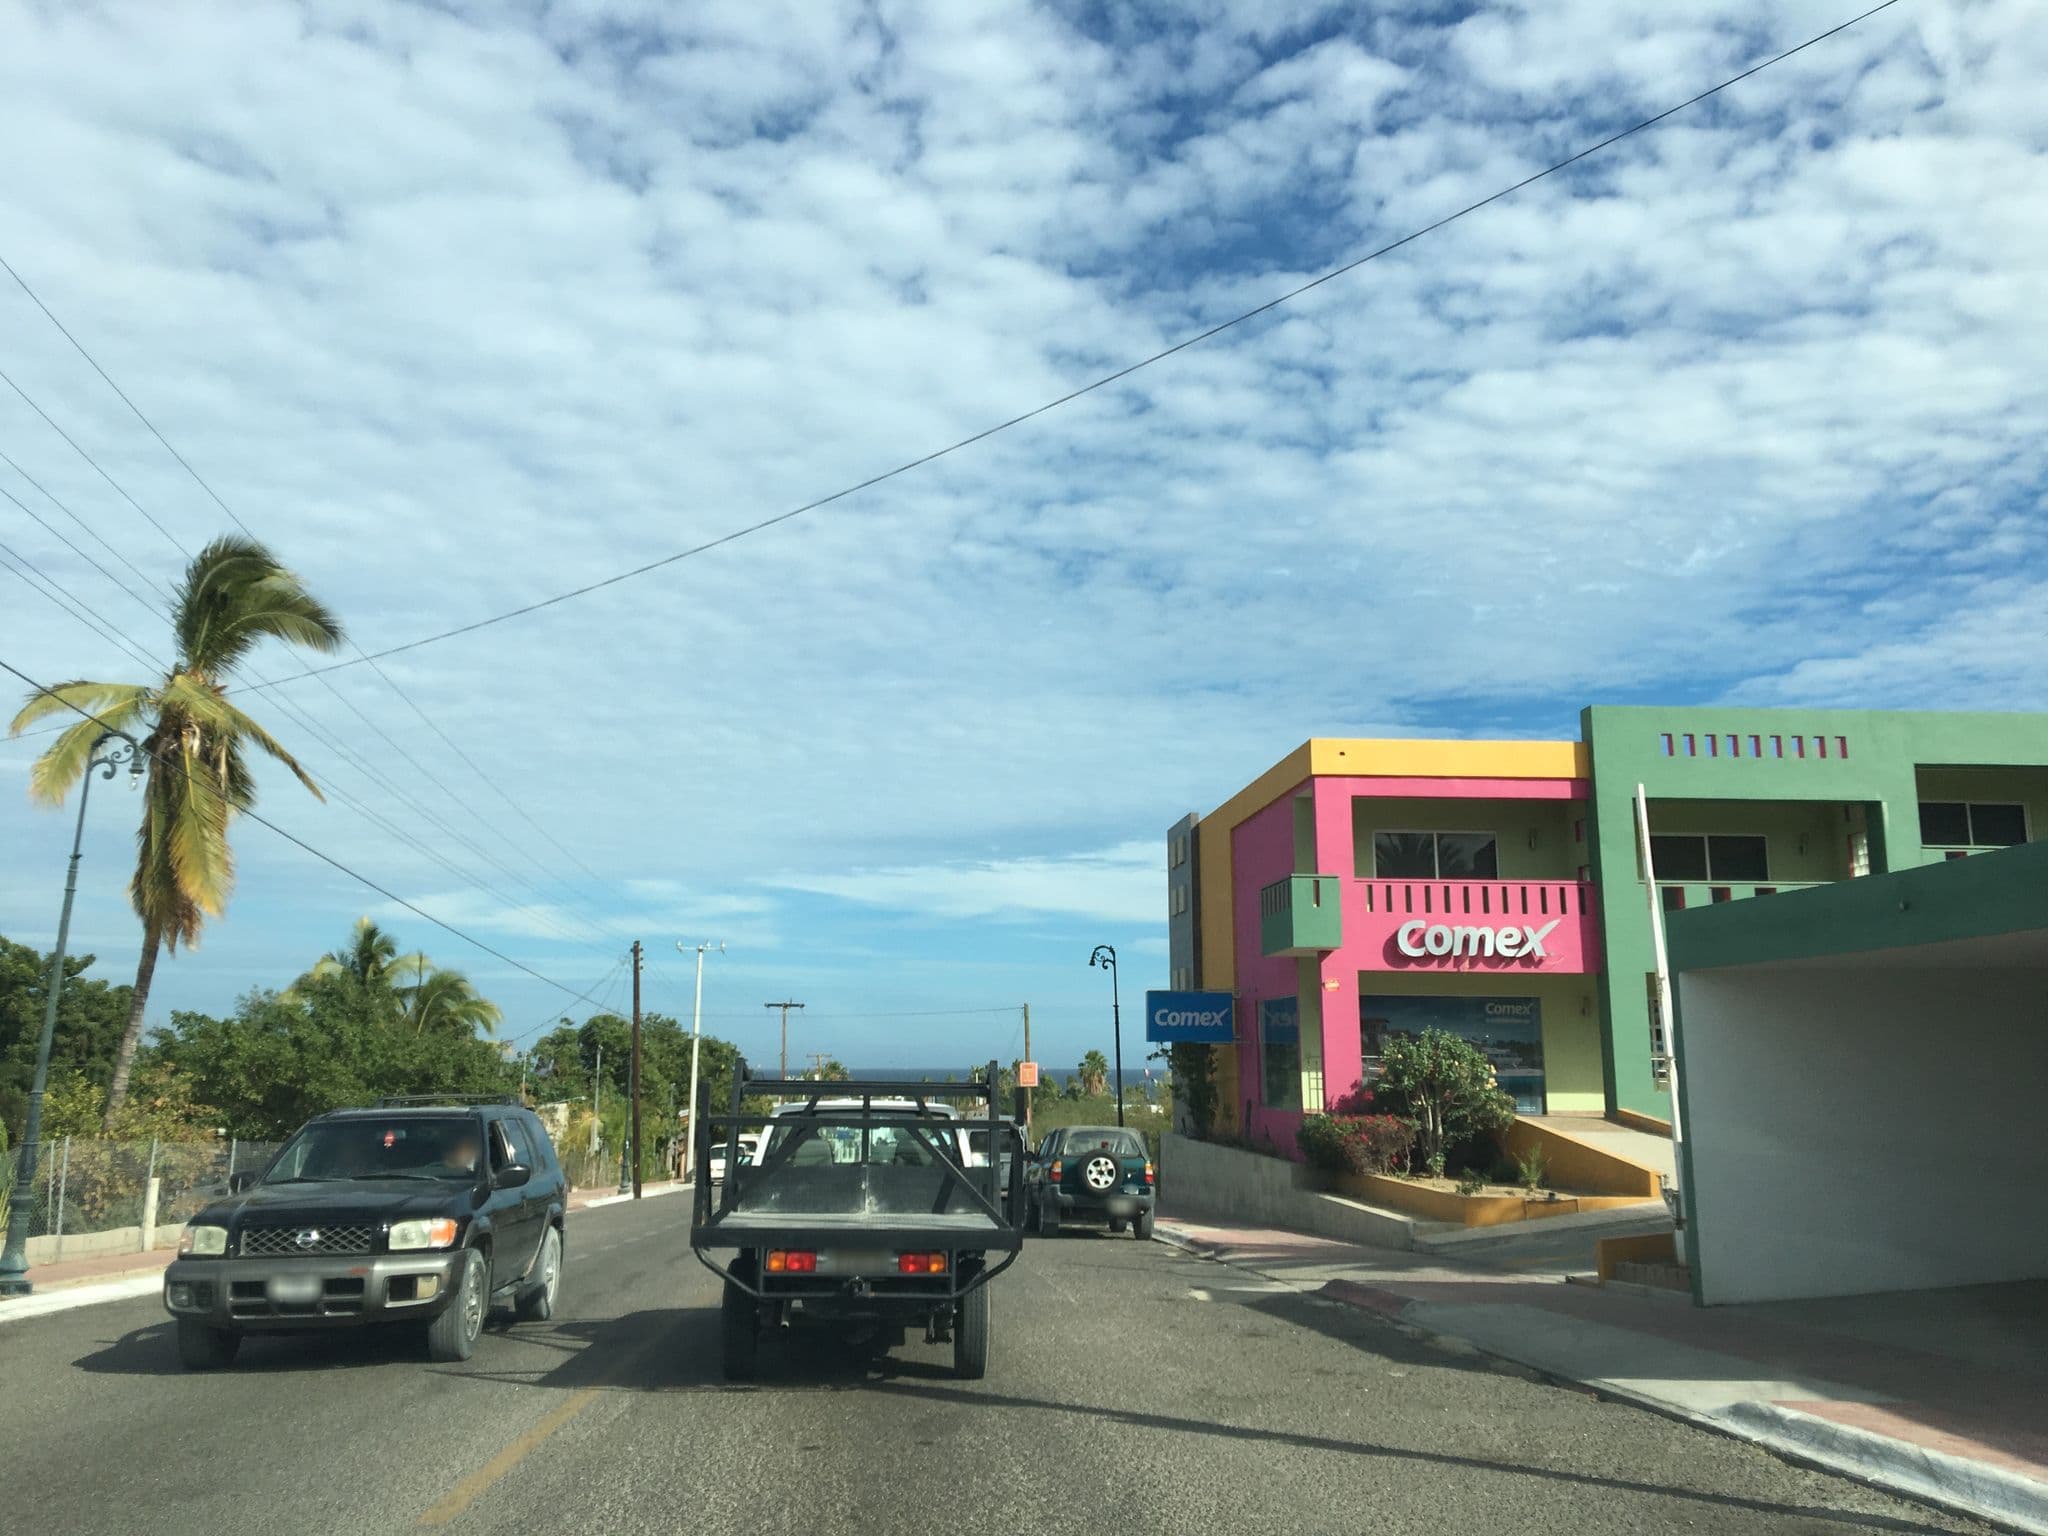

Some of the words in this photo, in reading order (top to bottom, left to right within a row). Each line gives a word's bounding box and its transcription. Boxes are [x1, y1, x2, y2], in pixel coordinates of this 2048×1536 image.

[1397, 919, 1561, 957] Comex
[1154, 1008, 1229, 1027] Comex
[1485, 1002, 1534, 1015] Comex
